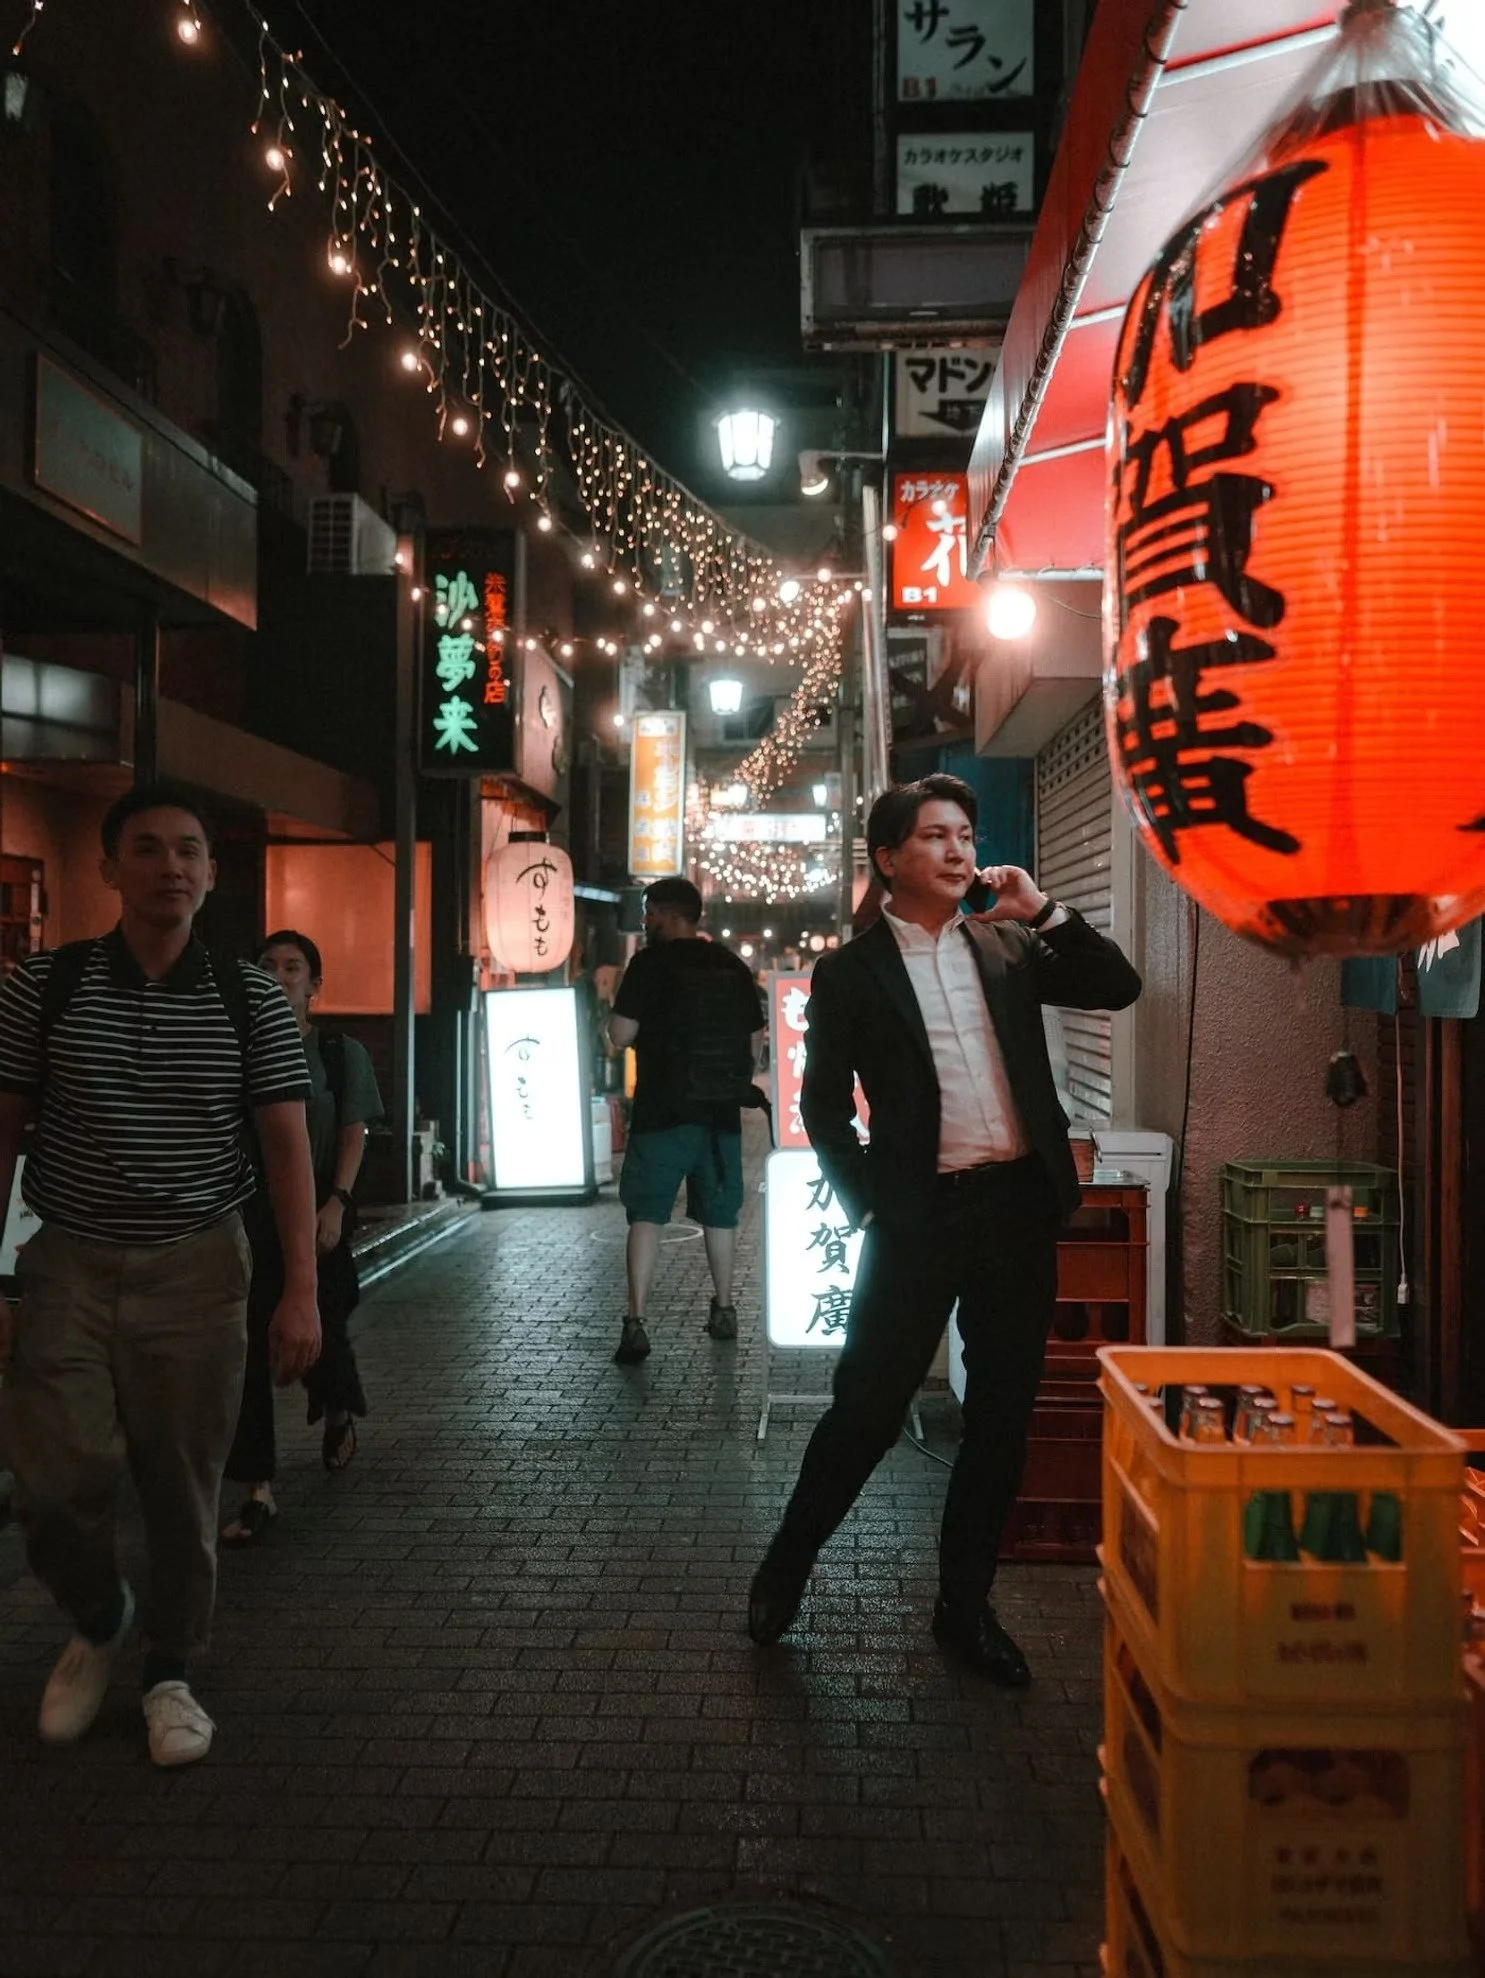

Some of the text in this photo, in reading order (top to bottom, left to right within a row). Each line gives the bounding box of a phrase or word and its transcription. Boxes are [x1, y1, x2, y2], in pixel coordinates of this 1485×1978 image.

[903, 0, 1028, 93] サラン
[903, 77, 937, 98] B1
[904, 146, 1023, 165] カラオケスタジオ
[905, 354, 995, 393] マドン
[901, 479, 959, 502] カラオケ
[902, 585, 938, 604] B1
[433, 570, 479, 755] 沙夢来
